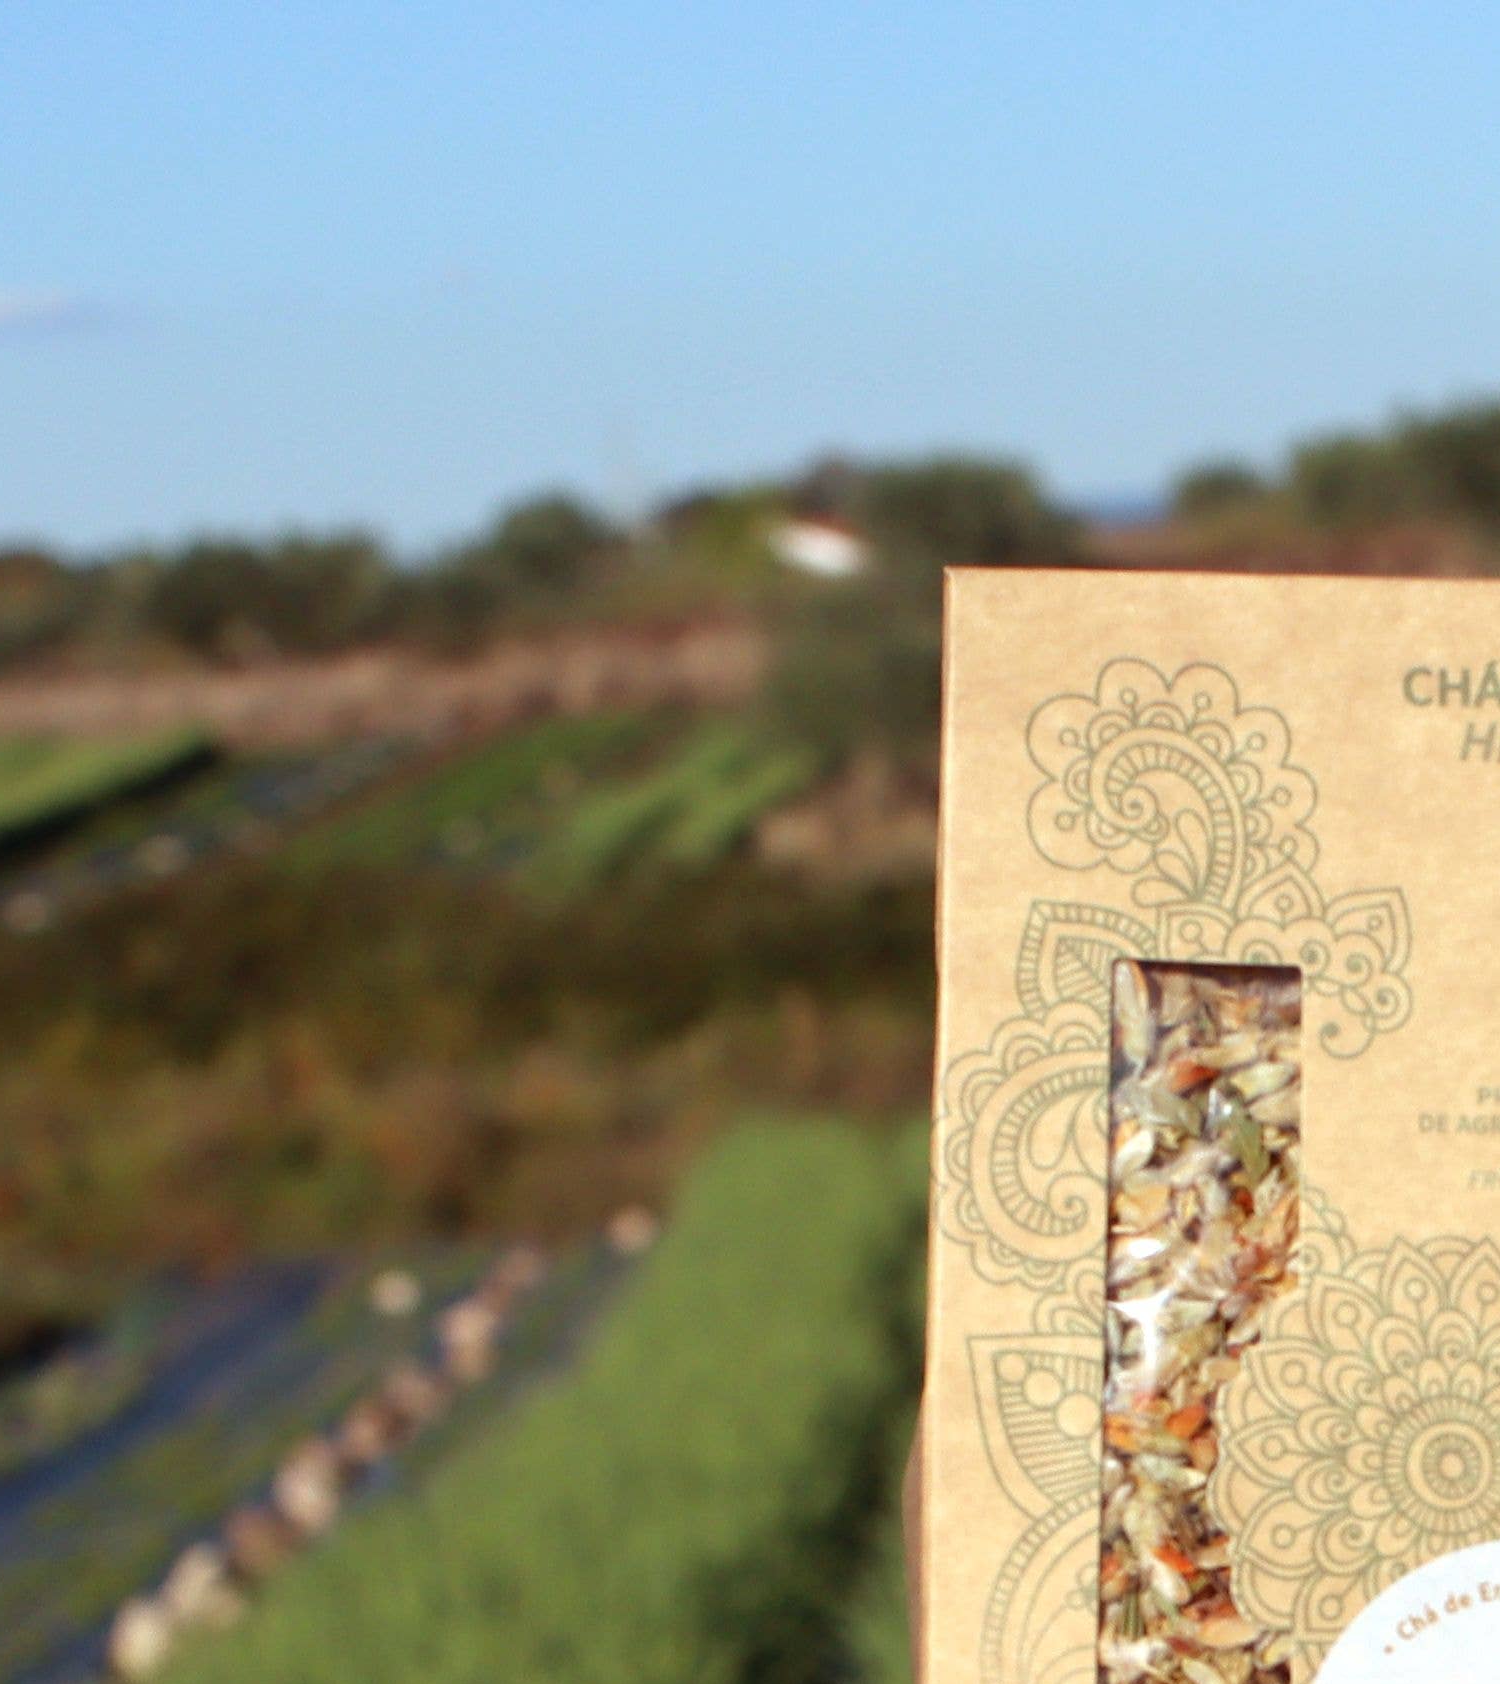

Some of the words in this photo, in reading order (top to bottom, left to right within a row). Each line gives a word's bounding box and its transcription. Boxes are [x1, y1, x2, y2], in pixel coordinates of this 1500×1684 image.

[1418, 1112, 1448, 1134] DE
[1396, 1602, 1439, 1640] Chá
[1444, 1591, 1473, 1614] de
